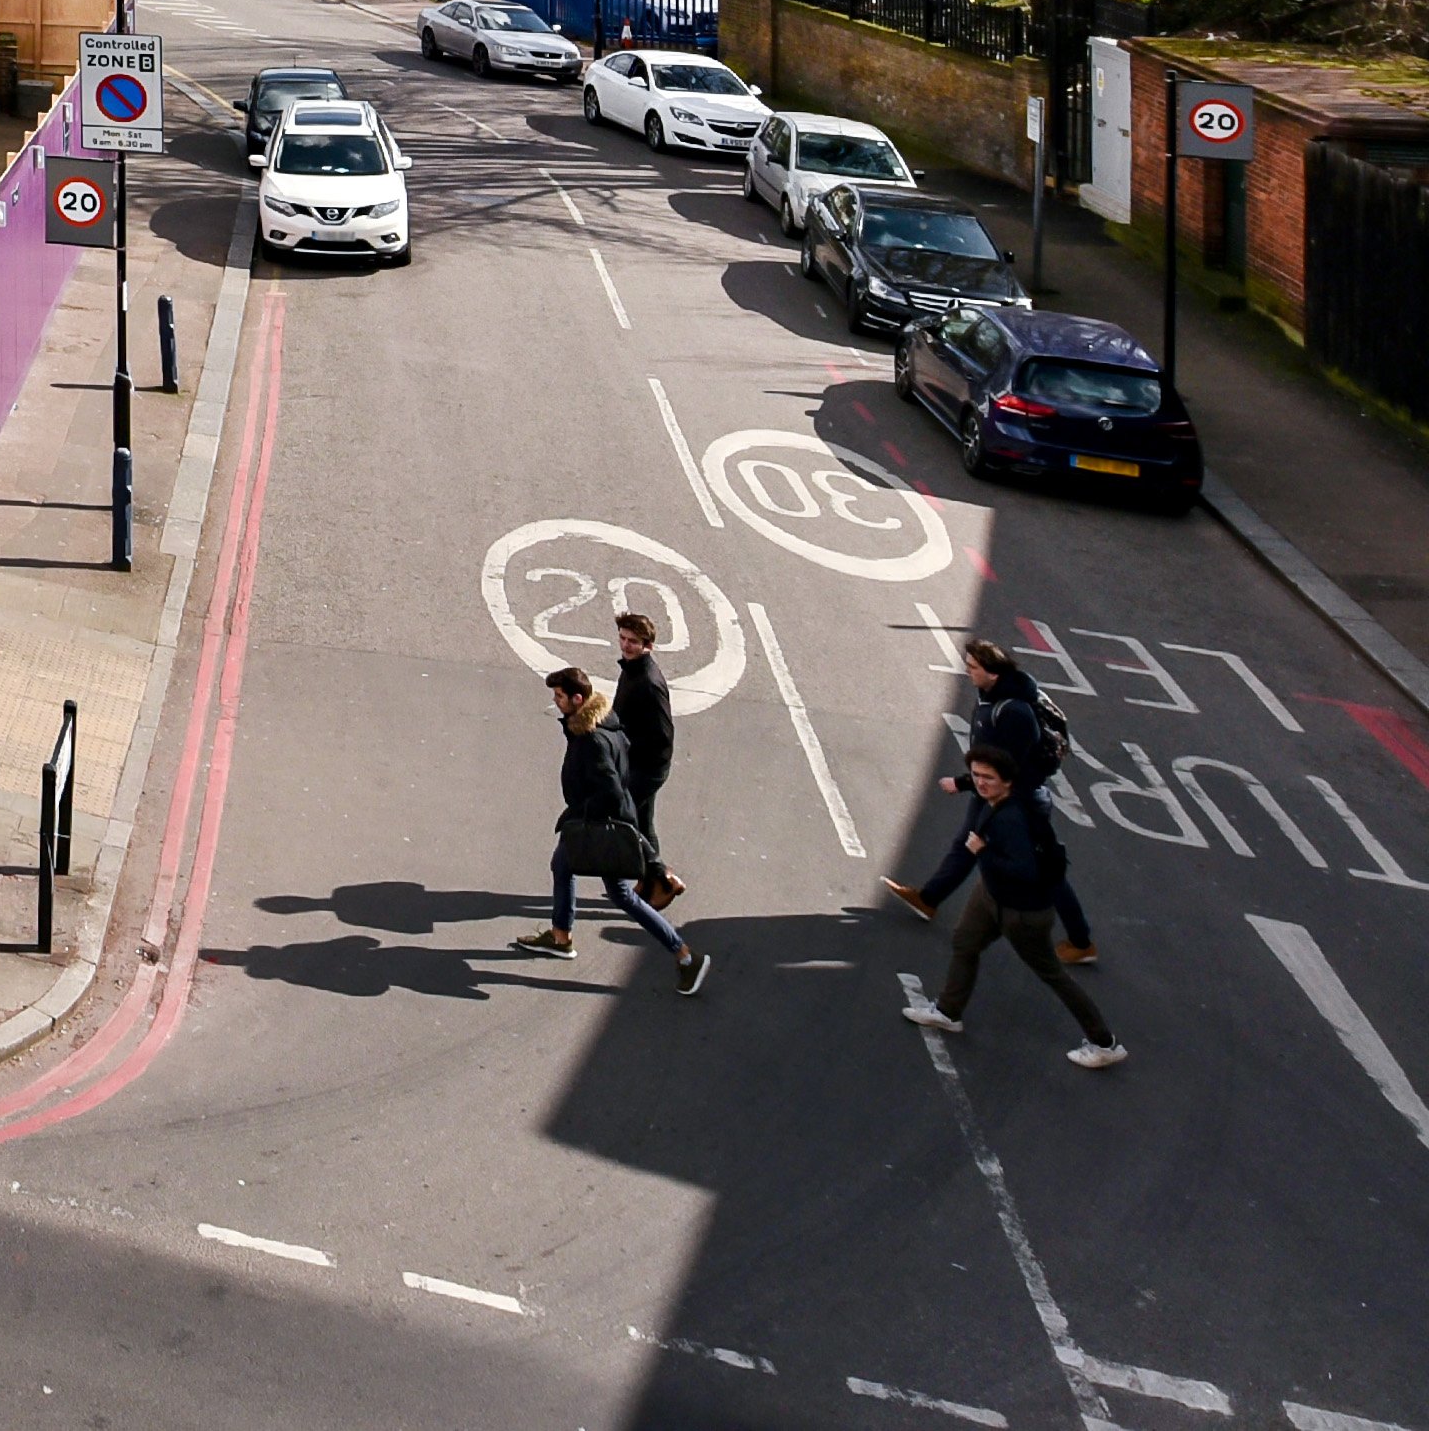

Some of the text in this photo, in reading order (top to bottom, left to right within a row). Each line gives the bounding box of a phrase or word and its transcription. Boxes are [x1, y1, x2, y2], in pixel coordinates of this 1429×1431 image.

[84, 37, 155, 52] Controlled
[86, 54, 136, 69] ZONE
[1197, 111, 1236, 131] 20
[103, 129, 143, 139] Mon Sat
[62, 191, 98, 213] 20
[737, 459, 903, 531] 30
[525, 567, 691, 652] 20
